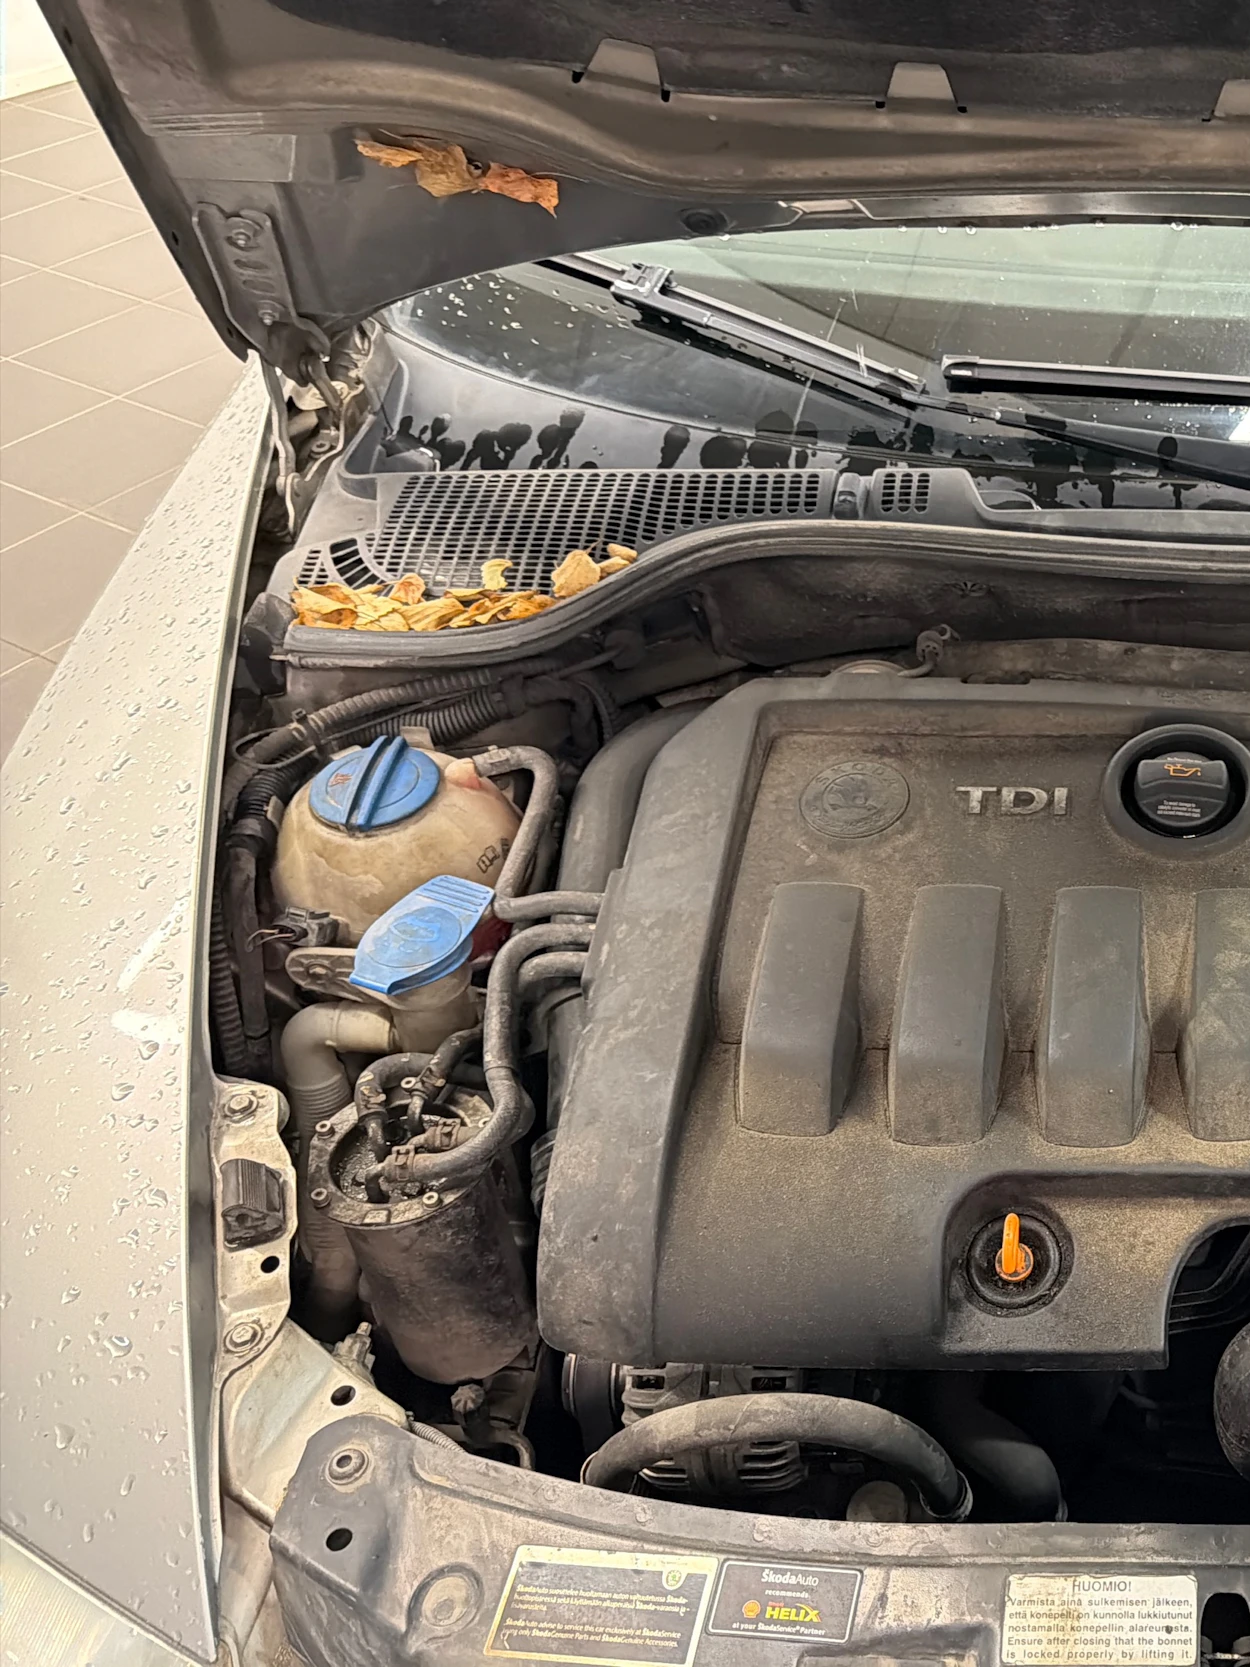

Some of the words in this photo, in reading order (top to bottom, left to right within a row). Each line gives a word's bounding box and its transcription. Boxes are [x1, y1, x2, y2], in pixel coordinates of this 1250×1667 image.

[956, 786, 1068, 815] TDI
[761, 1568, 819, 1586] ŠkodaAuto
[1072, 1580, 1132, 1592] HUOMIO!
[1011, 1598, 1055, 1606] Varmista
[1060, 1598, 1082, 1606] aina
[1088, 1598, 1148, 1606] sulkemisen
[1152, 1598, 1192, 1608] jälkeen,
[765, 1603, 821, 1622] HELIX
[1008, 1610, 1027, 1619] että
[1030, 1610, 1074, 1622] konepelti
[1077, 1612, 1090, 1620] on
[1093, 1610, 1135, 1620] kunnolla
[1138, 1610, 1192, 1620] lukkiutunut
[584, 1624, 594, 1632] this
[740, 1622, 756, 1630] your
[800, 1626, 826, 1636] Partner
[1008, 1624, 1065, 1632] nostamalla
[1070, 1624, 1124, 1634] konepellin
[1008, 1636, 1043, 1646] Ensure
[1046, 1636, 1070, 1646] after
[1074, 1636, 1111, 1648] closing
[1114, 1636, 1134, 1646] that
[1138, 1636, 1154, 1646] the
[1158, 1636, 1192, 1646] bonnet
[1006, 1650, 1016, 1658] is
[1024, 1650, 1060, 1658] locked
[1067, 1650, 1114, 1660] properly
[1122, 1650, 1134, 1660] by
[1142, 1650, 1174, 1660] lifting
[1182, 1650, 1192, 1658] it.
